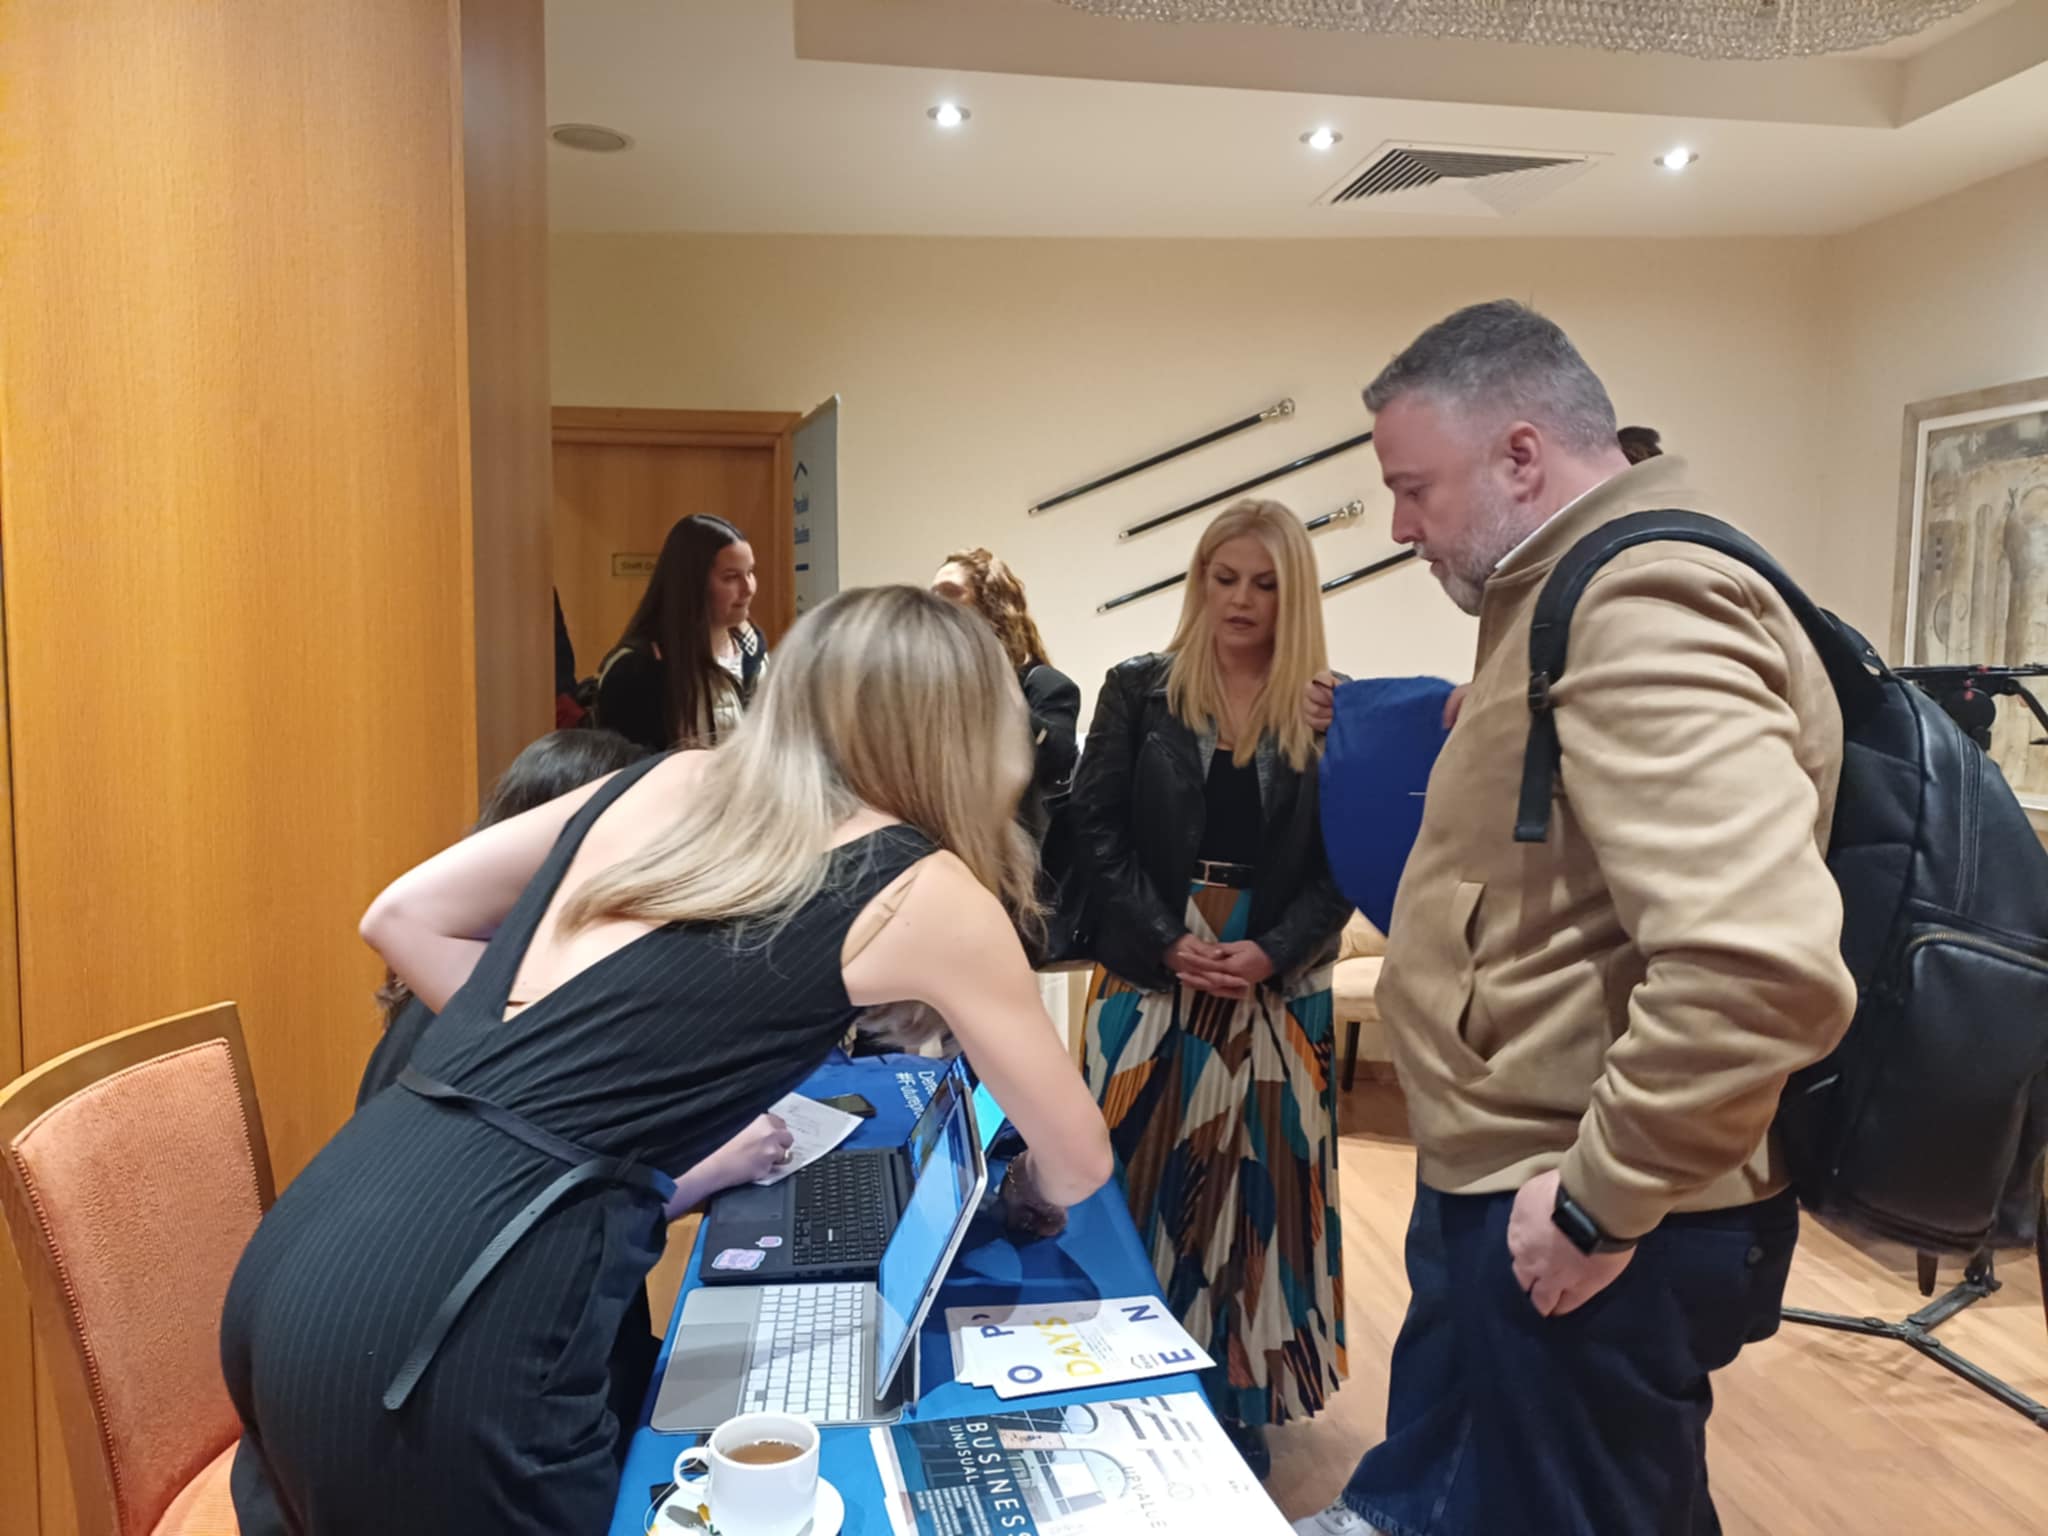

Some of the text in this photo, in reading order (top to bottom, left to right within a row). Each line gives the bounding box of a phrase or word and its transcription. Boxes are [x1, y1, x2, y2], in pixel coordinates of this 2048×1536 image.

[1033, 1316, 1104, 1378] DAYS
[948, 1424, 980, 1484] UNUSUAL
[965, 1422, 1034, 1536] BUSINES
